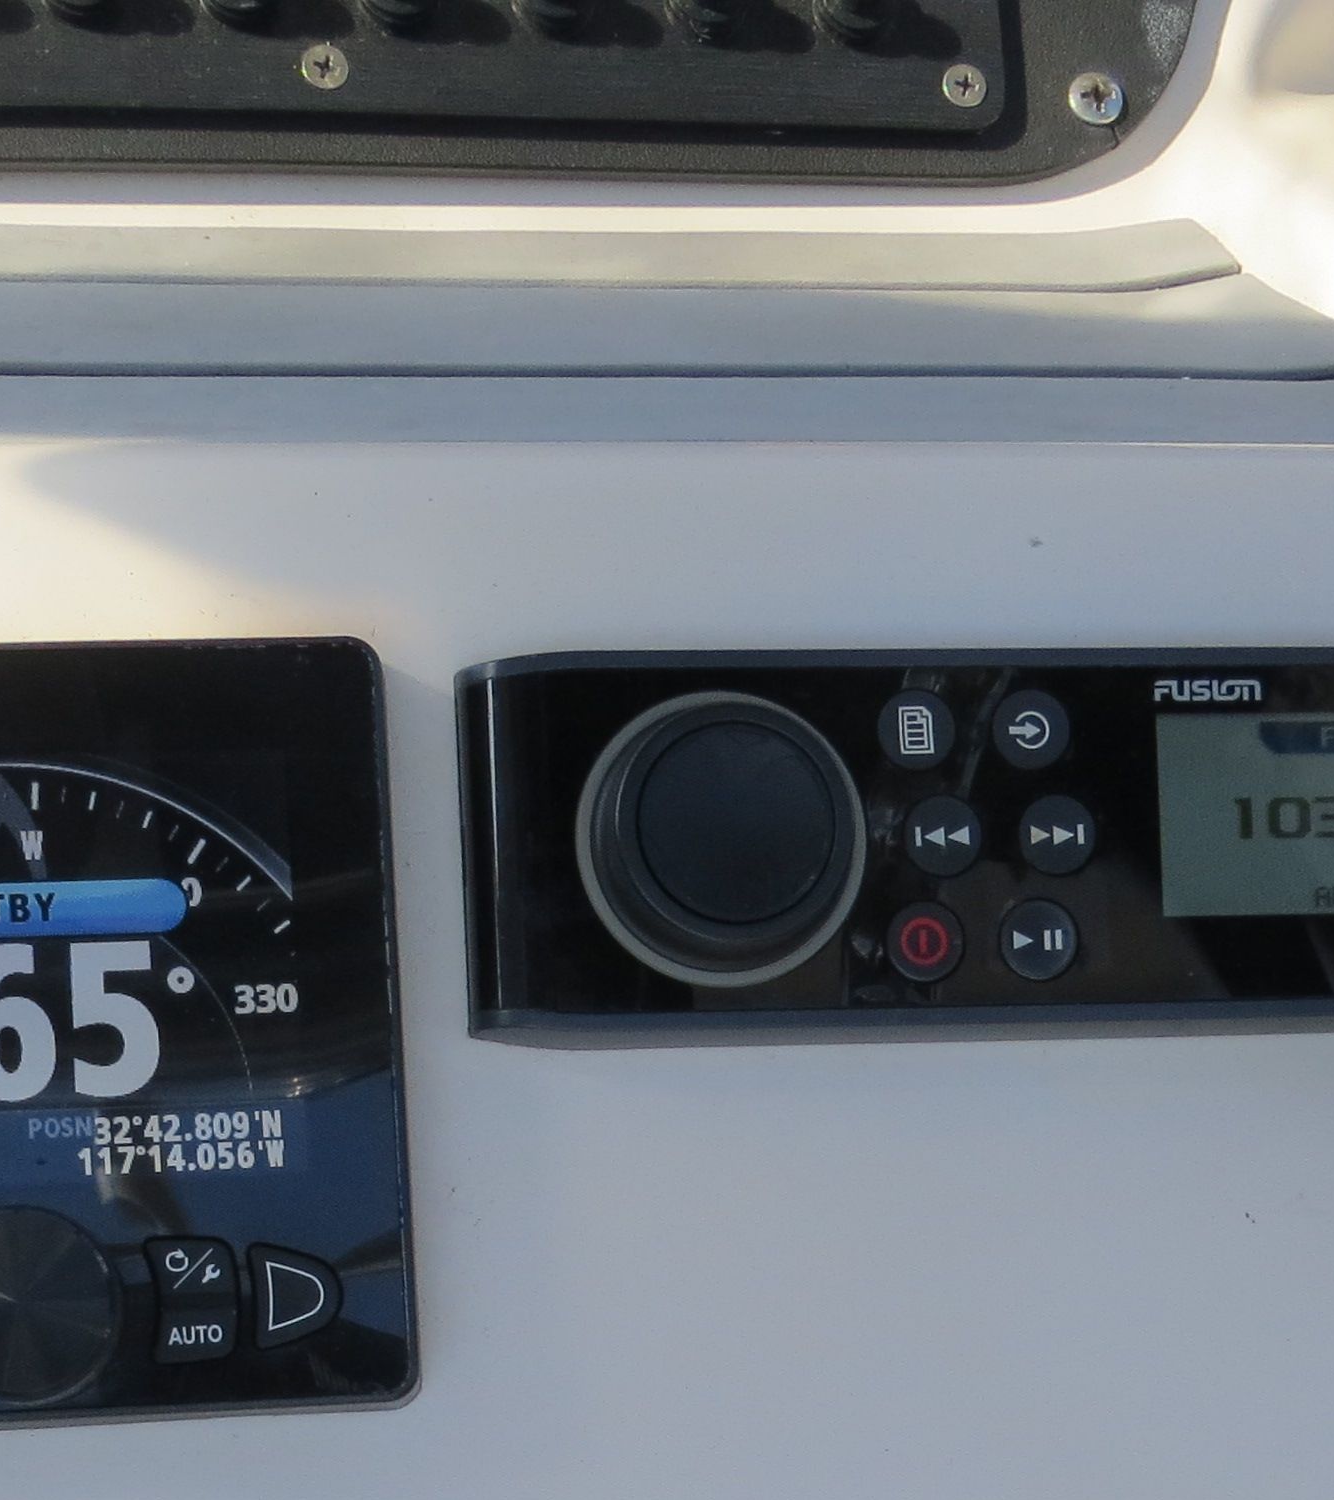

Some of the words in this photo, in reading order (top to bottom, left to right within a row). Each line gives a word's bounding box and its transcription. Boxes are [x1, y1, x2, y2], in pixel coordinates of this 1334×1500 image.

[1154, 679, 1262, 702] FUSION
[20, 831, 44, 861] W
[234, 983, 299, 1017] 330
[28, 1115, 92, 1139] POSN
[167, 1321, 224, 1347] AUTO
